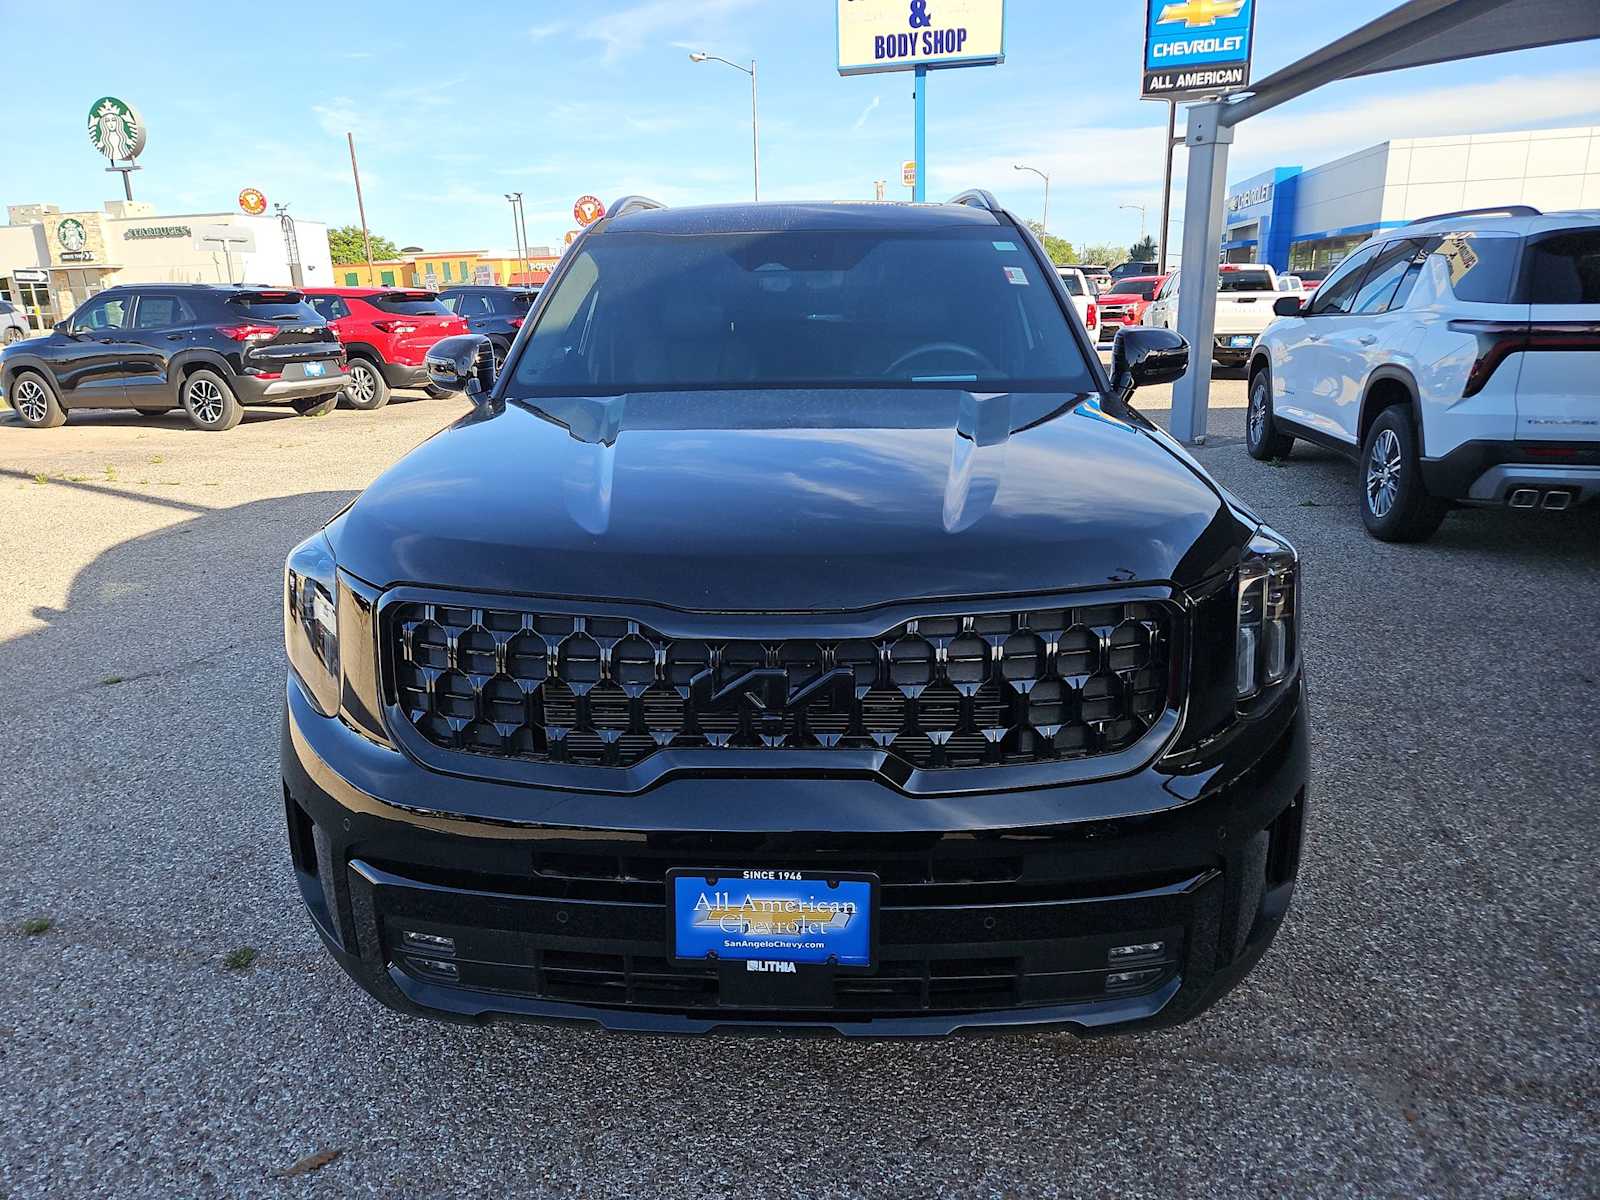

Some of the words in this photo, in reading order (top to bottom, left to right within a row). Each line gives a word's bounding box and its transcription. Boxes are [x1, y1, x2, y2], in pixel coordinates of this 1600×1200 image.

[909, 0, 931, 28] &
[875, 32, 918, 59] BODY
[923, 28, 967, 55] SHOP
[1153, 36, 1243, 58] CHEVROLET
[1150, 76, 1174, 90] ALL
[1176, 69, 1243, 87] AMERICAN
[126, 226, 190, 239] STARBUCKS
[743, 870, 775, 880] SINCE
[778, 871, 802, 881] 1946
[693, 892, 730, 912] All
[741, 894, 857, 914] American
[719, 914, 828, 935] Chevrolet
[724, 940, 825, 950] SanAngeloChevy.com
[758, 960, 797, 974] LITHIA
